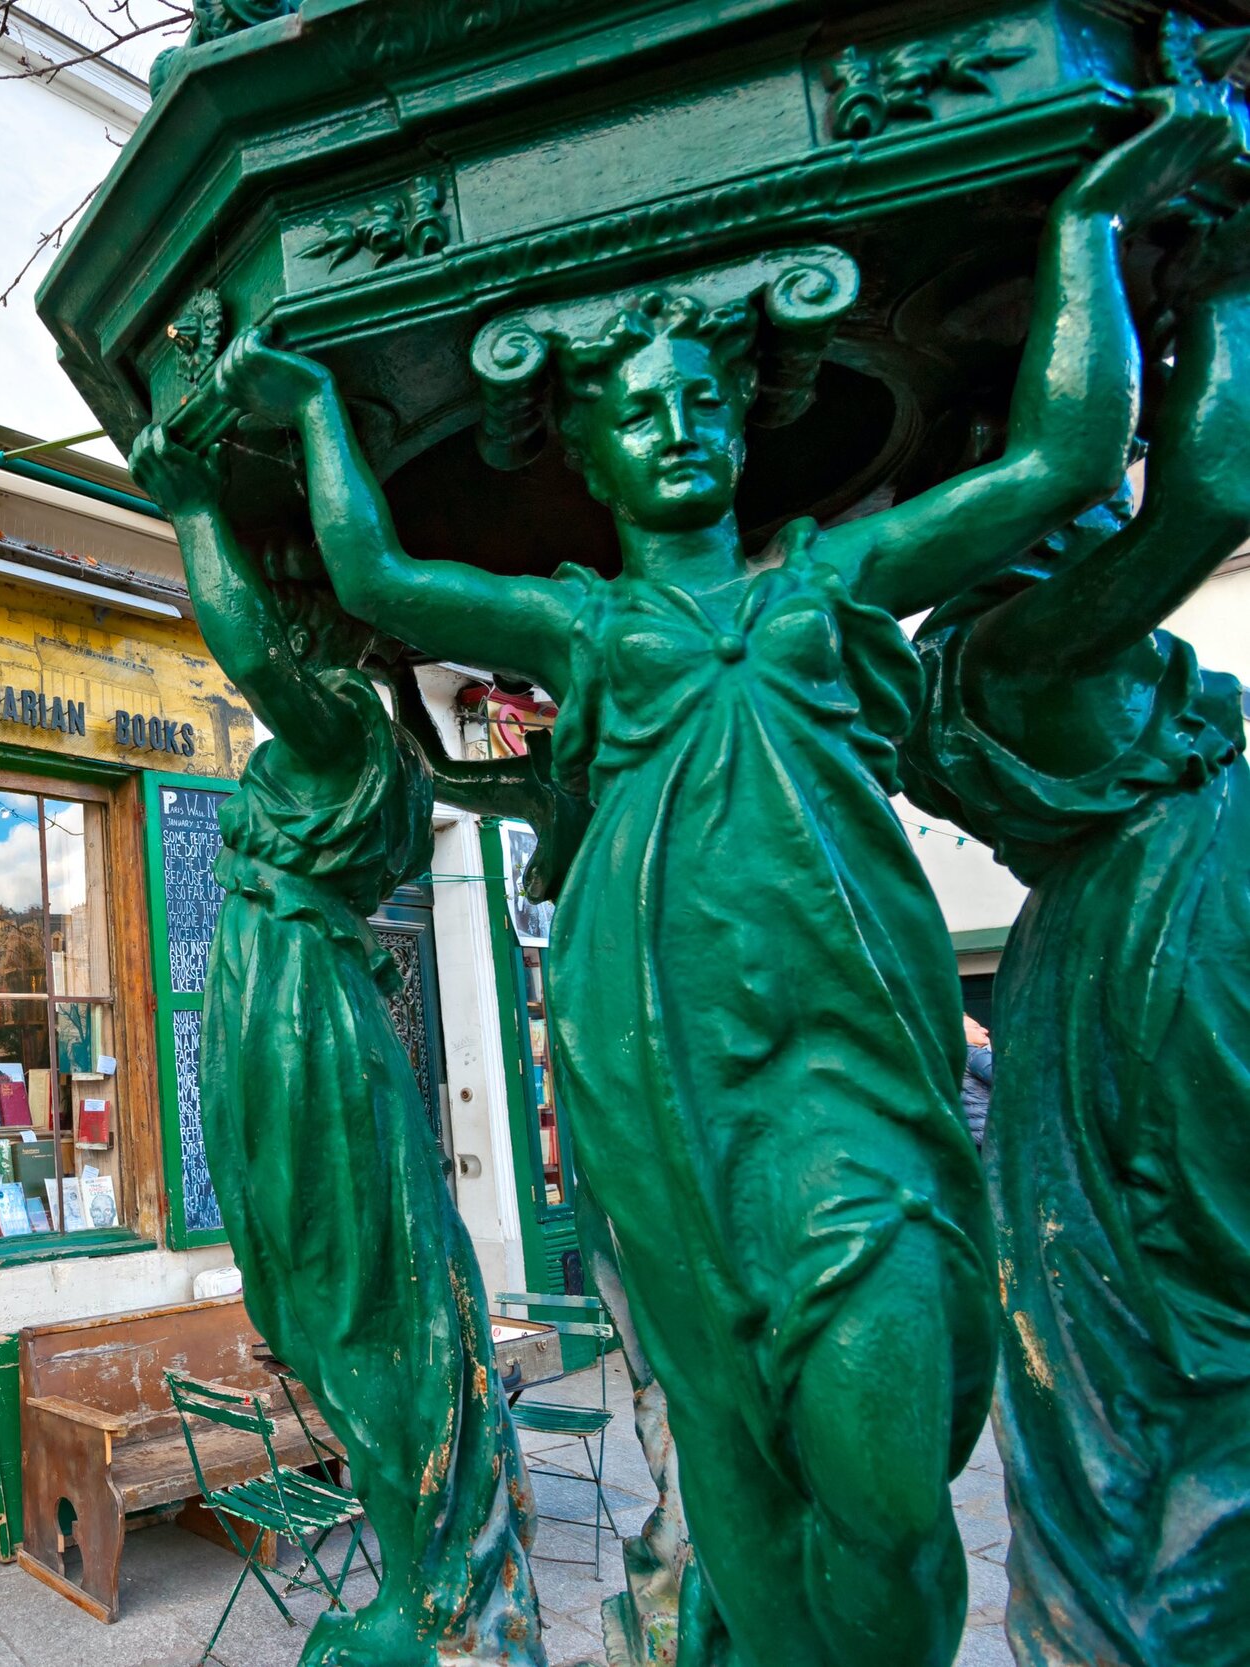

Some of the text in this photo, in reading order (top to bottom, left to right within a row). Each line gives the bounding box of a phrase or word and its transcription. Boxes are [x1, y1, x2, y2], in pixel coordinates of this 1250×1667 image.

[115, 709, 195, 757] BOOKS
[162, 791, 184, 815] PARIS
[166, 818, 193, 828] JANUARY
[163, 830, 215, 846] SOME PEOPLE
[163, 843, 202, 858] THE DON
[165, 857, 195, 872] OF THE
[165, 870, 204, 887] BECAUSE
[165, 885, 219, 901] IS SO FAR UP
[166, 900, 222, 915] CLOUDS THAT
[168, 914, 215, 929] IMAGINE ALL
[168, 927, 200, 941] ANGELS
[169, 941, 189, 956] AND
[170, 955, 204, 968] BEING A
[172, 979, 201, 992] LIKE A
[173, 1022, 198, 1035] ROOMS
[174, 1034, 190, 1050] IN A
[174, 1049, 196, 1062] FACT
[177, 1074, 197, 1089] MORE
[178, 1088, 190, 1102] MY
[179, 1112, 201, 1127] IS THE
[181, 1156, 197, 1169] THE
[183, 1169, 190, 1183] A
